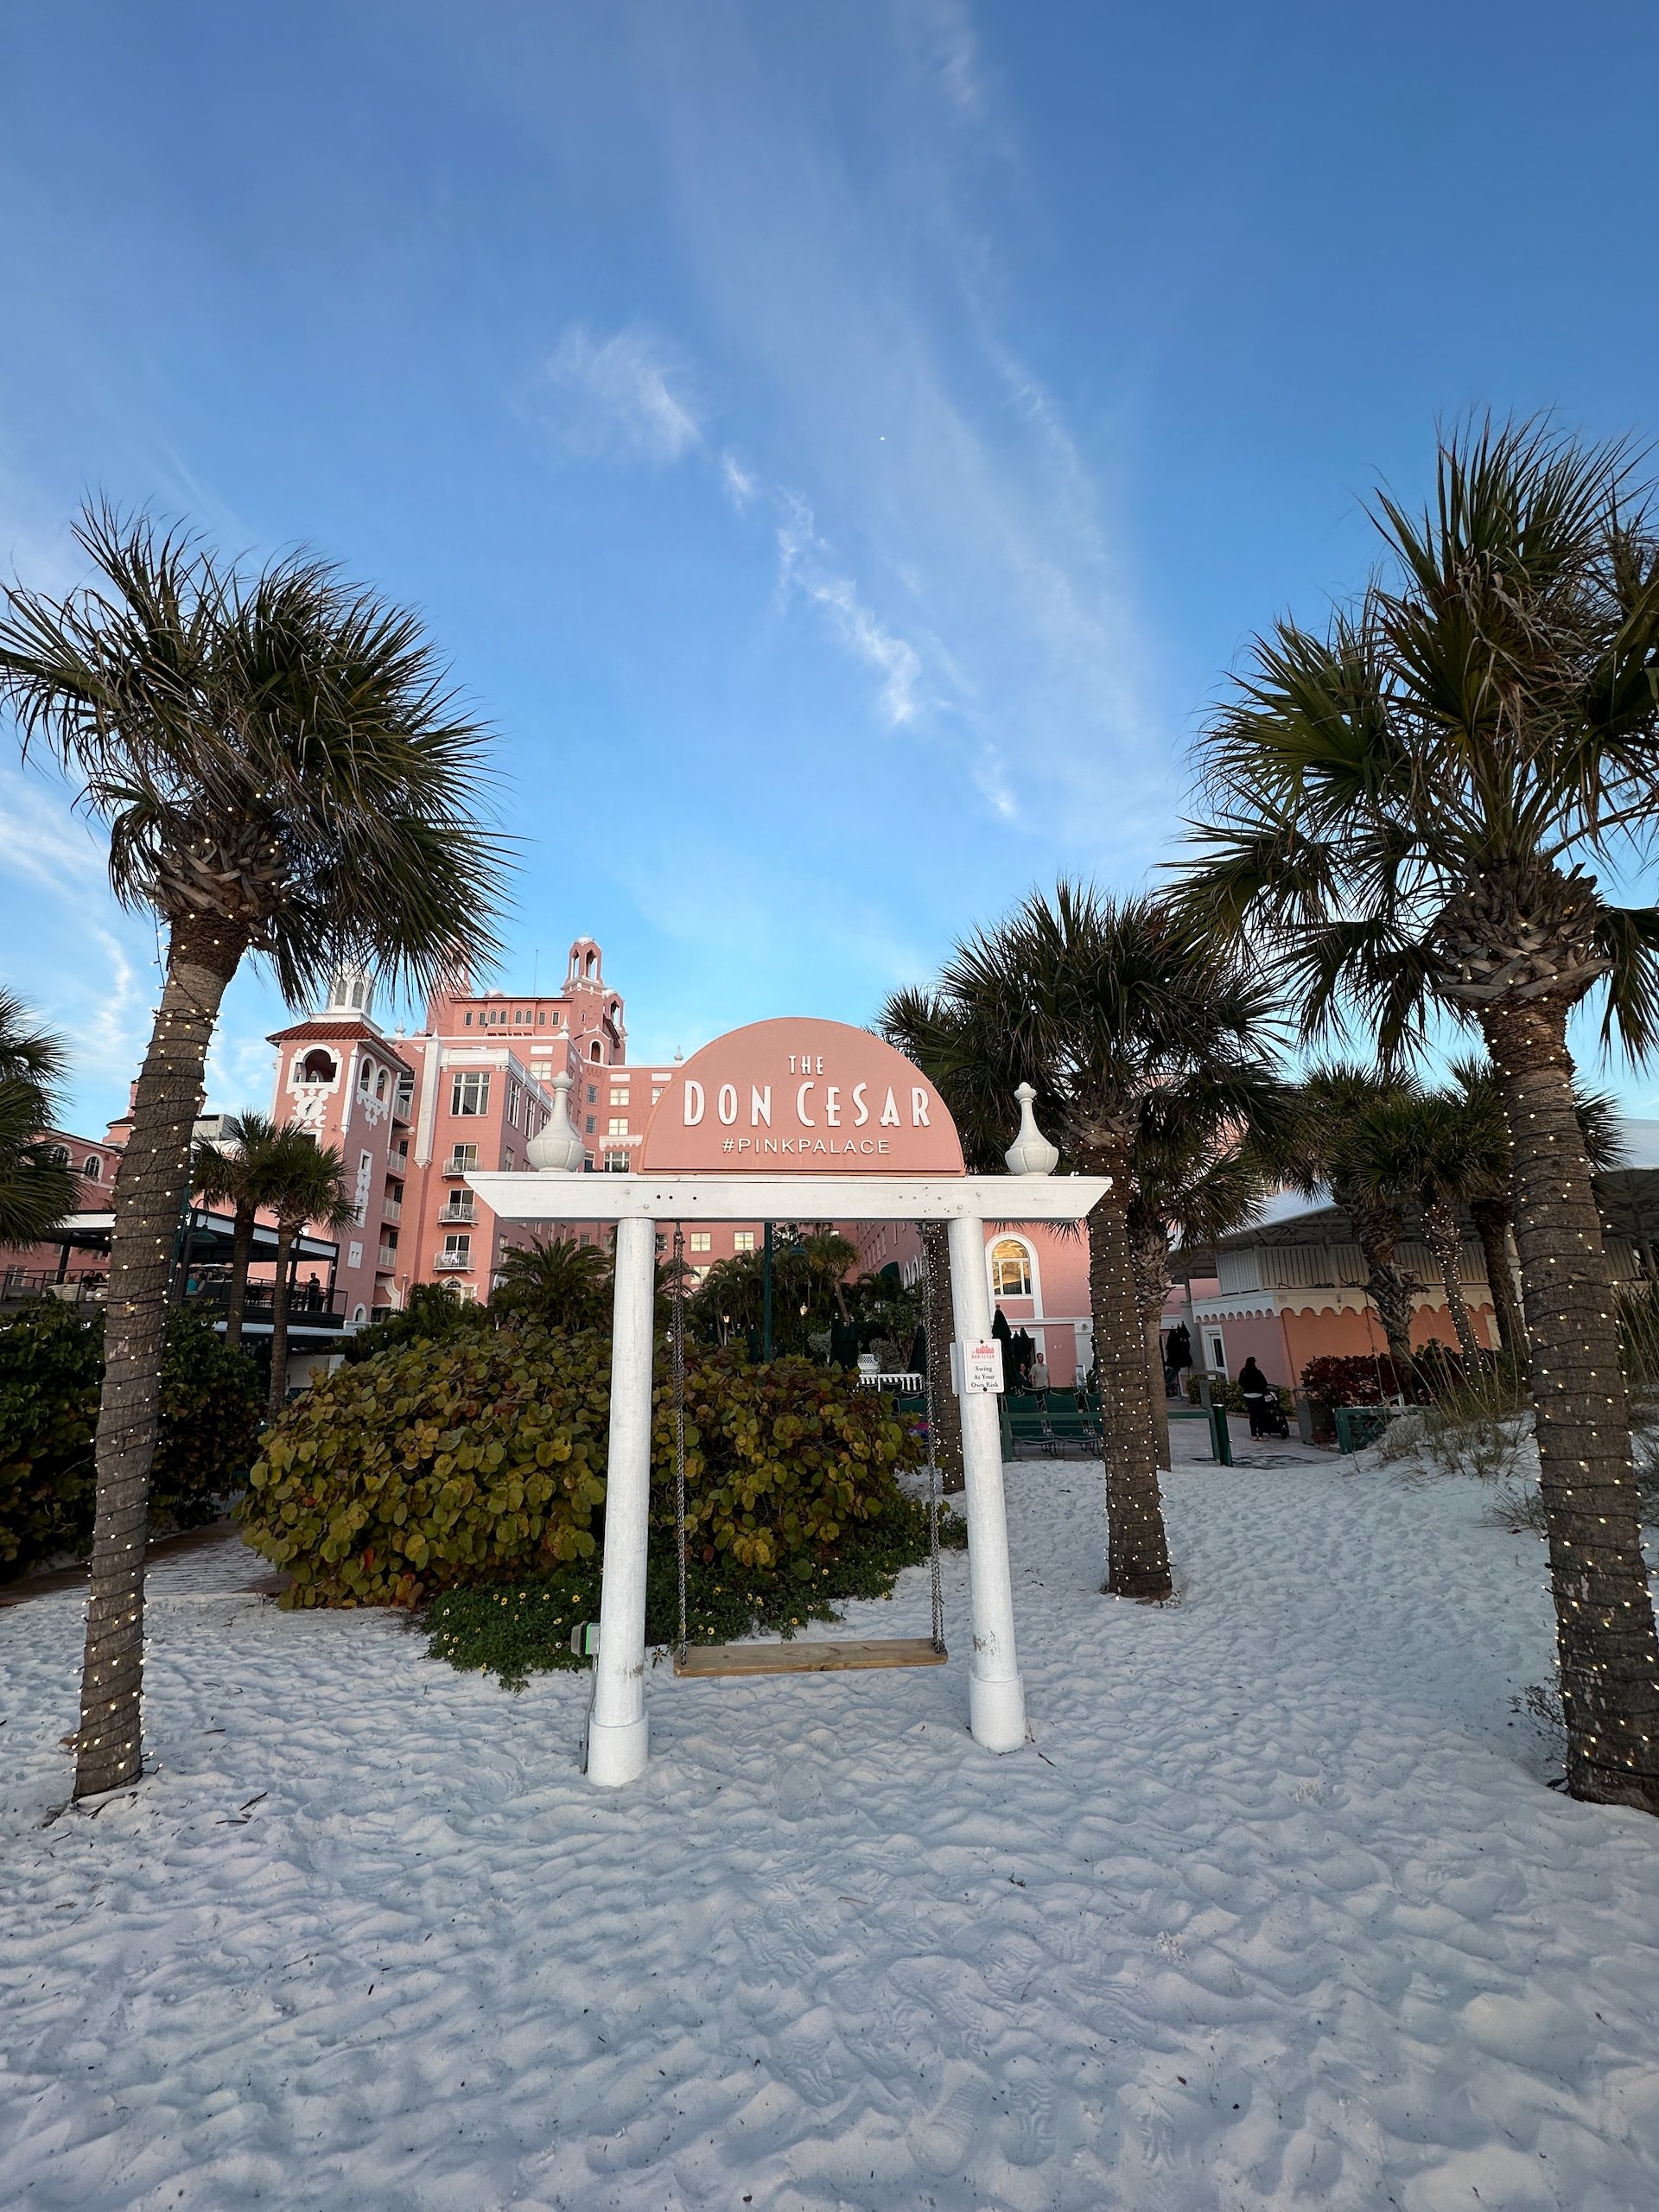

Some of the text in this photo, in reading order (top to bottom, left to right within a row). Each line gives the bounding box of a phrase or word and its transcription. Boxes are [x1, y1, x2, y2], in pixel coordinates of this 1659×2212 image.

[789, 1055, 823, 1075] THE
[683, 1080, 931, 1128] DON CESAR
[722, 1137, 891, 1154] #PINKPALACE
